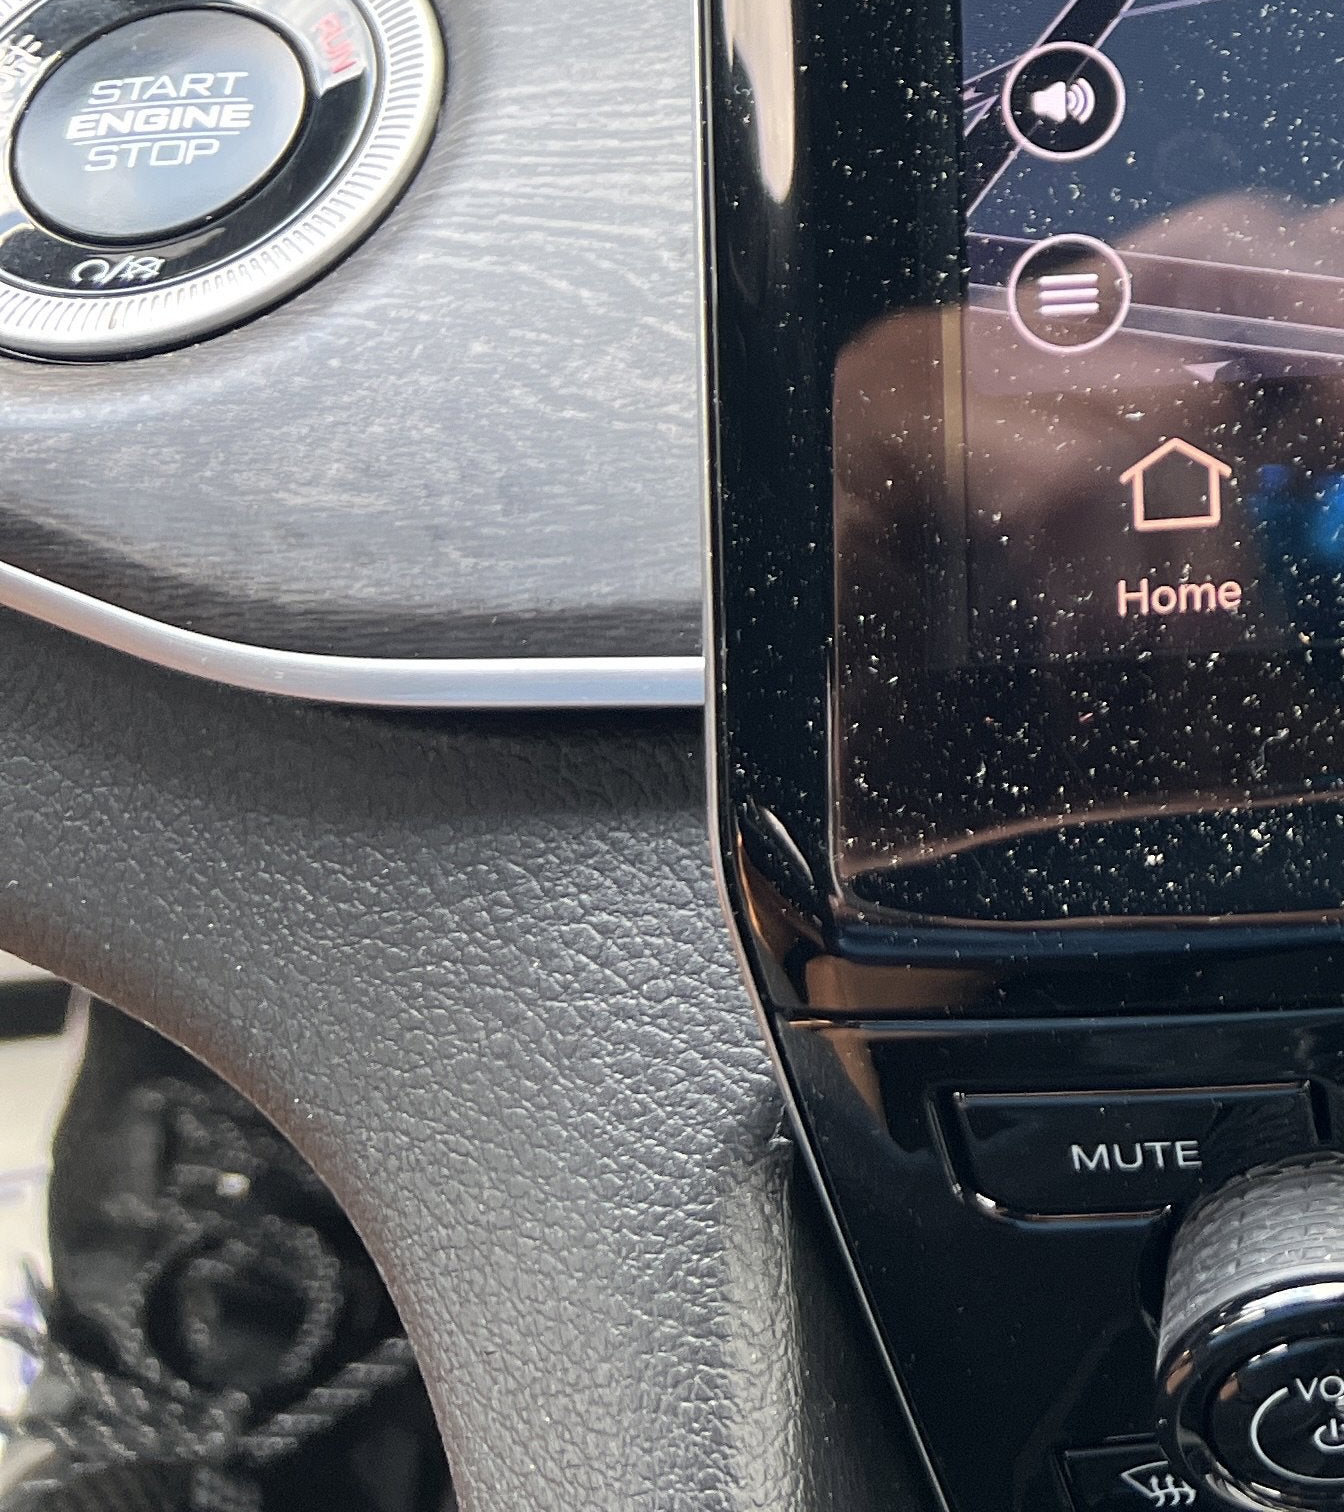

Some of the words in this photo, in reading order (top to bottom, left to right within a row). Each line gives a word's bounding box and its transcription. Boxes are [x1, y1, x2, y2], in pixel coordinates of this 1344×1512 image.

[310, 12, 359, 74] RUN
[88, 71, 249, 106] START
[65, 104, 255, 141] ENGINE
[84, 139, 220, 172] STOP
[1117, 574, 1243, 618] Home
[1071, 1140, 1202, 1172] MUTE
